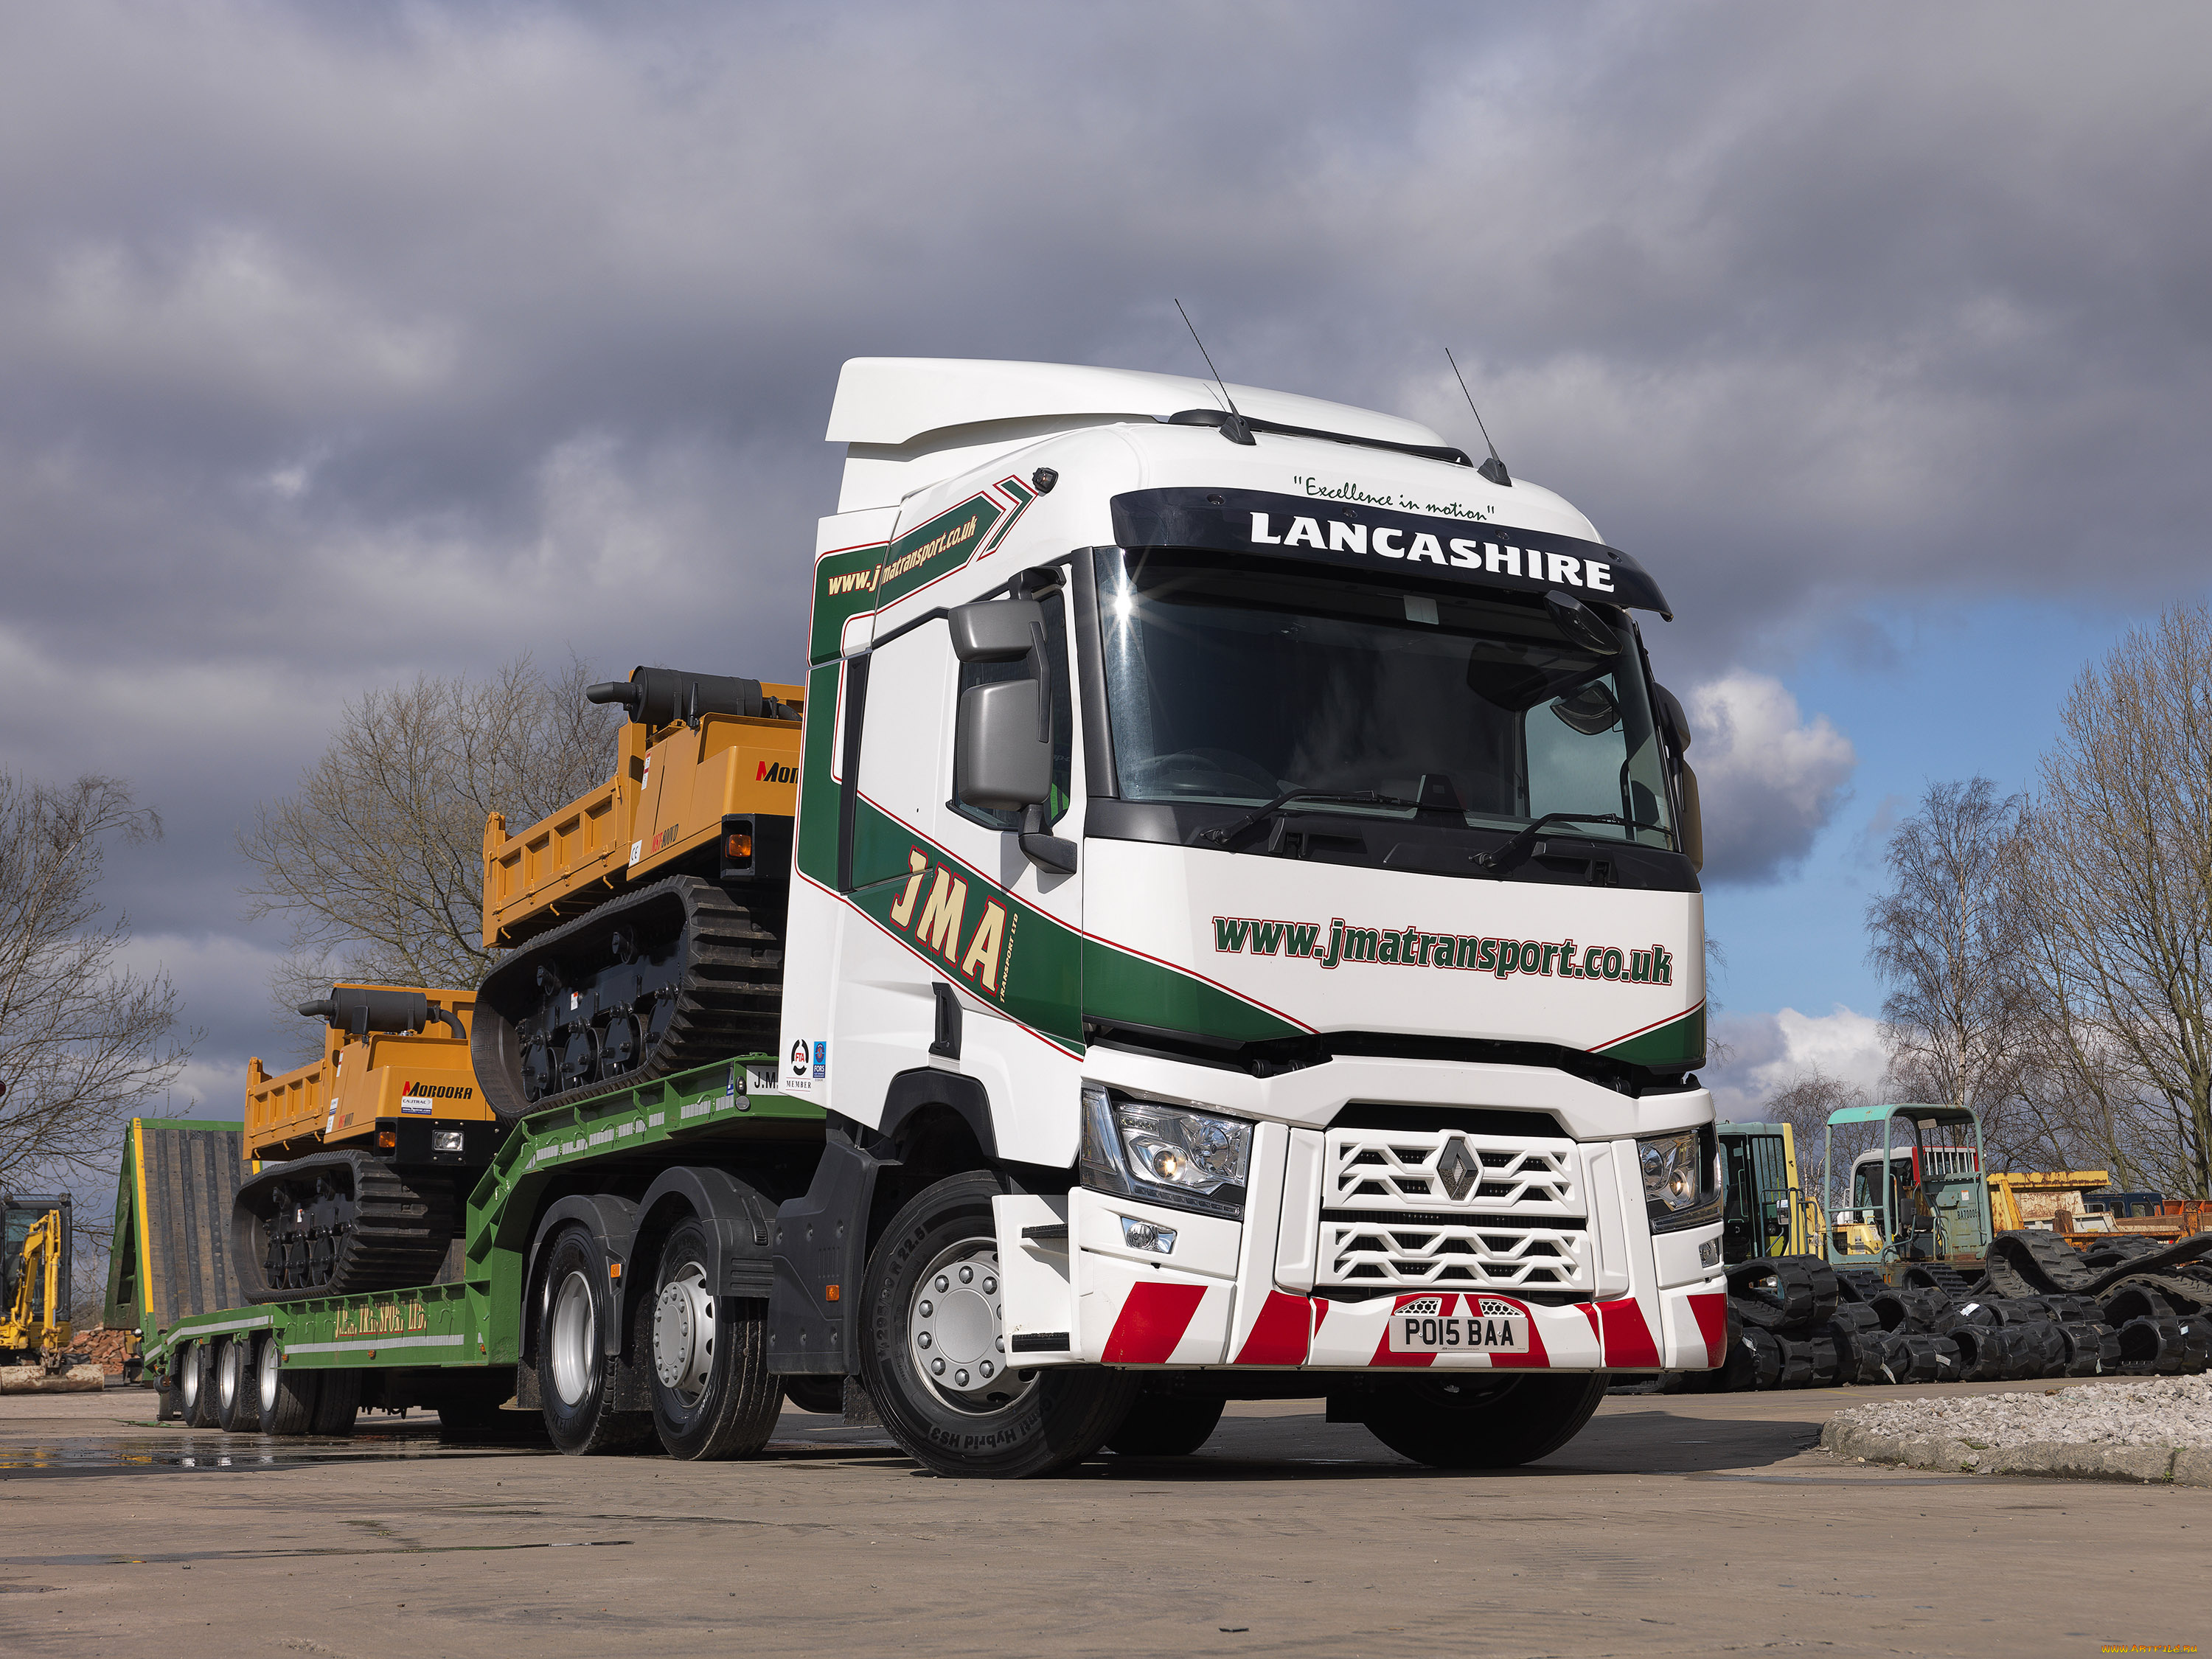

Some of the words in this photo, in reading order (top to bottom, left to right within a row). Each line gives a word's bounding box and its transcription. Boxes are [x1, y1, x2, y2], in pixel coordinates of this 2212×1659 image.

[1293, 475, 1393, 507] "Excellence
[1399, 493, 1420, 510] in
[1425, 502, 1495, 521] motion"
[828, 514, 978, 597] www.jmatransport.co.uk
[1249, 511, 1615, 594] LANCASHIRE
[890, 845, 1007, 997] JMA
[1000, 935, 1015, 1003] TRANSPORT
[1011, 913, 1019, 935] LTD
[1212, 916, 1673, 987] www.jmatransport.co.uk
[795, 1052, 804, 1062] FTA
[786, 1080, 811, 1088] MEMBER
[1467, 1320, 1514, 1346] BAA
[929, 1427, 961, 1448] HS3
[964, 1428, 1017, 1450] Hybrid
